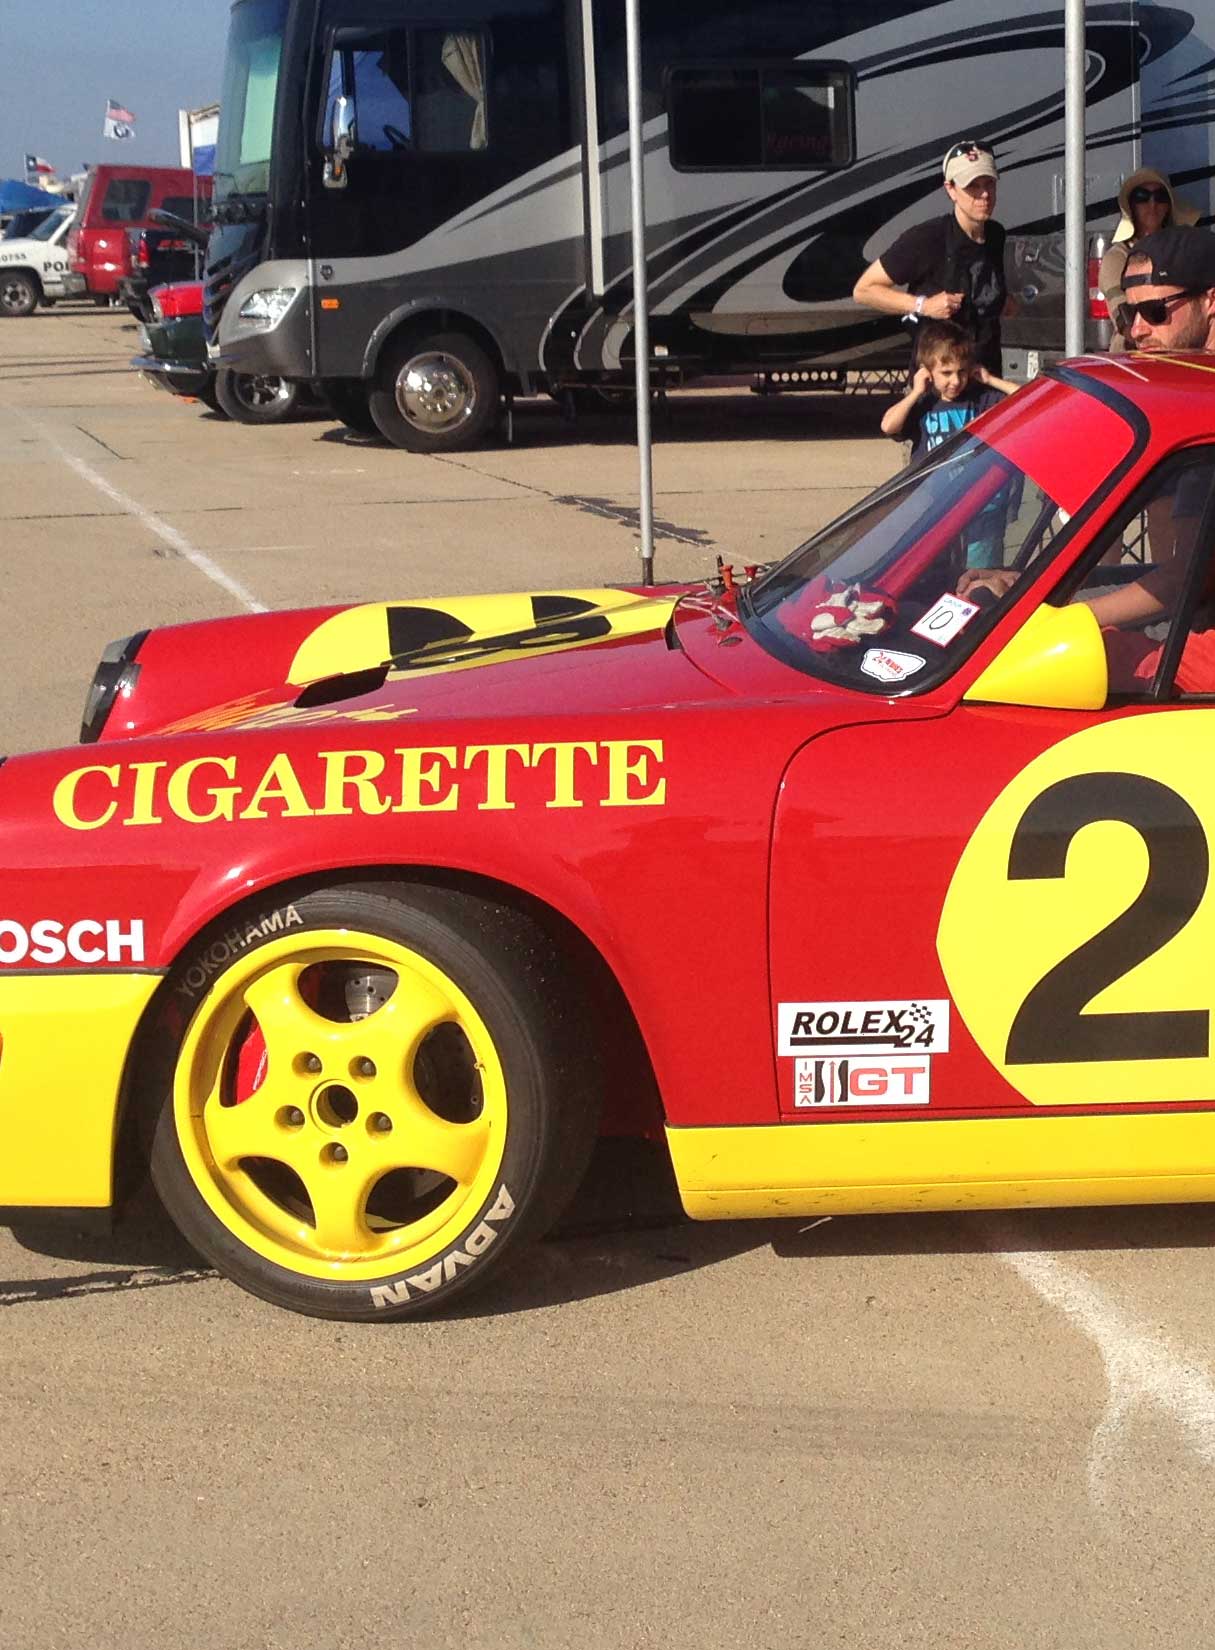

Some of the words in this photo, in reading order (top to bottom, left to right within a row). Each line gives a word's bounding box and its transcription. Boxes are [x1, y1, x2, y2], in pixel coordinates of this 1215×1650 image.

[921, 605, 954, 631] 10
[52, 739, 667, 830] CIGARETTE
[176, 904, 304, 998] YOKOHAMA
[792, 1010, 908, 1035] ROLEX
[894, 1025, 935, 1048] 24
[799, 1061, 813, 1105] IMSA
[850, 1067, 926, 1097] GT
[369, 1183, 516, 1308] ADVAN
